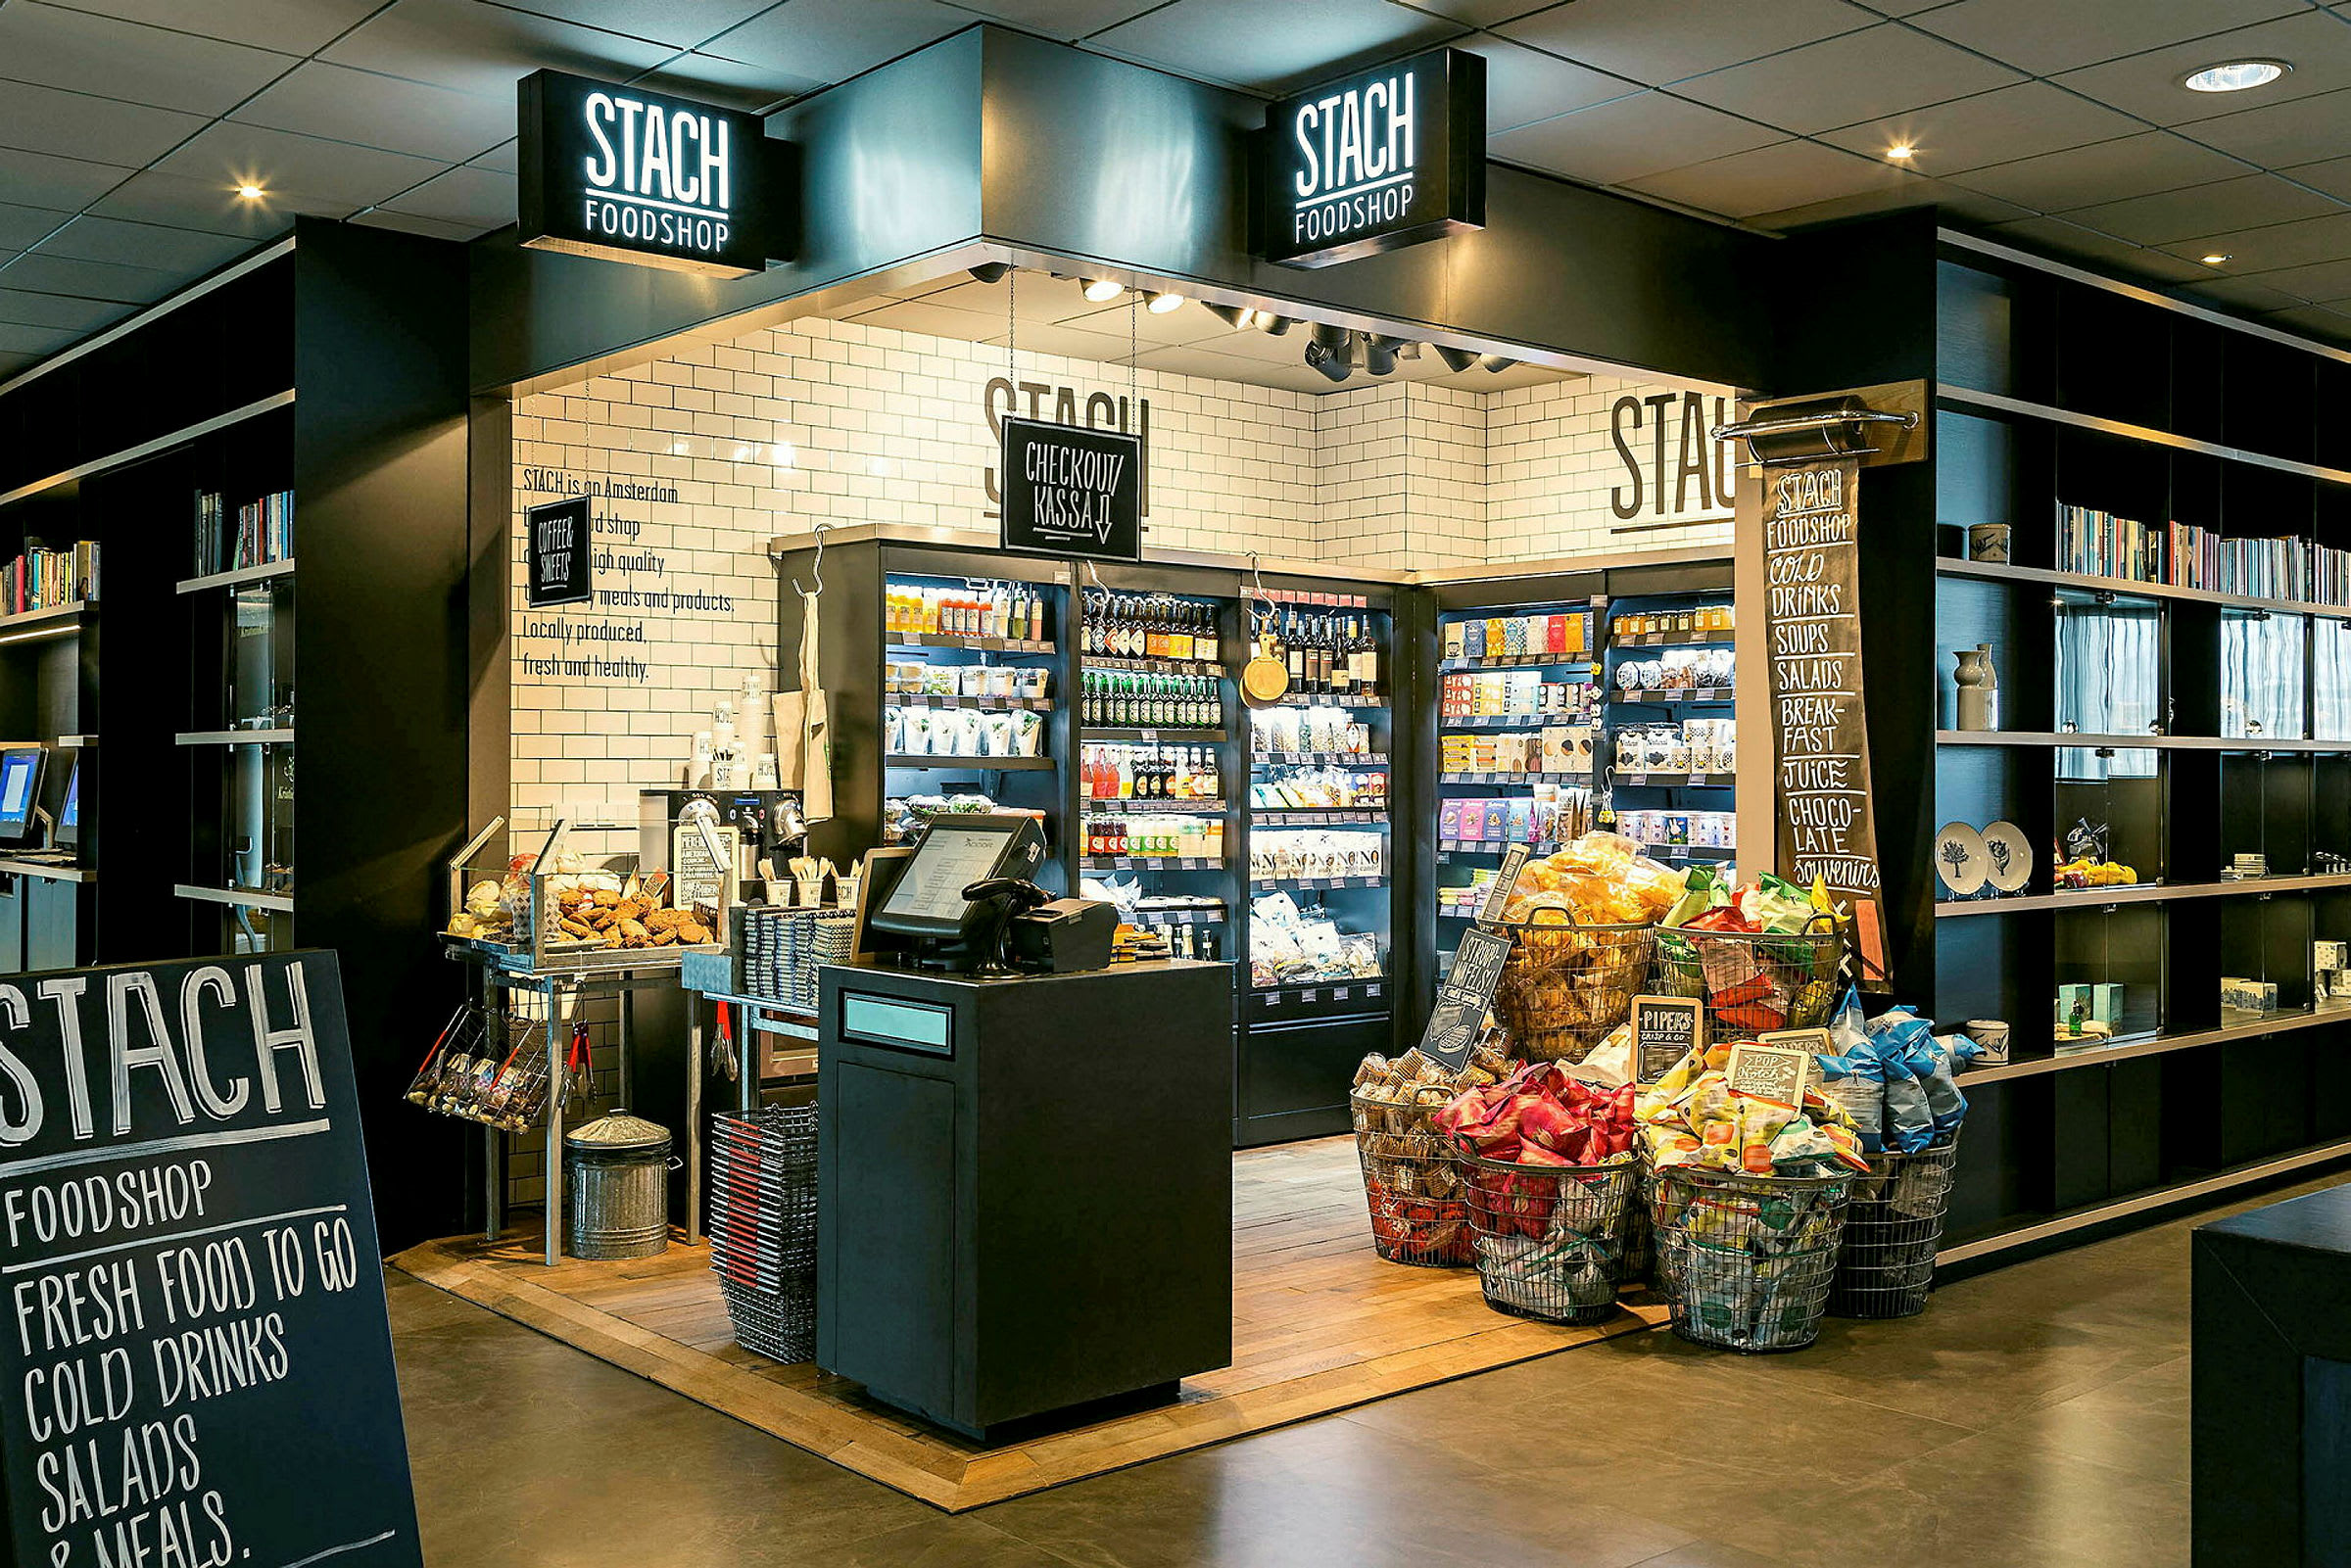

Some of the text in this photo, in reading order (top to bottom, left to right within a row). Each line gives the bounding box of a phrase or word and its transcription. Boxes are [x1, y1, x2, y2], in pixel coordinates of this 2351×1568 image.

[585, 92, 729, 210] STACH
[1295, 71, 1414, 197] STACH
[585, 200, 729, 253] FOODSHOP
[1295, 184, 1414, 244] FOODSHOP
[1610, 391, 1735, 520] STAC
[523, 468, 679, 504] STACH is an Amsterdam
[1776, 469, 1842, 513] STACH
[1033, 485, 1093, 530] KASSA
[606, 512, 641, 542] shop
[1766, 513, 1851, 549] FOODSHOP
[541, 551, 571, 583] SWEETS
[593, 547, 665, 579] igh quality
[1769, 553, 1824, 585] COLD
[600, 585, 641, 607] meals
[644, 588, 669, 609] and
[672, 589, 735, 615] products.
[523, 615, 647, 646] Locally produced,
[1775, 623, 1830, 655] SOUPS
[524, 652, 649, 685] fresh and healthy.
[1777, 660, 1843, 690] SALADS
[1783, 727, 1838, 754] FAST
[1793, 827, 1850, 854] LATE
[1643, 1010, 1692, 1032] PIPERS
[0, 960, 326, 1147] STACH
[1754, 1056, 1779, 1067] POP
[4, 1160, 212, 1247] FOODSHOP
[14, 1216, 358, 1355] FRESH FOOD TO GO
[24, 1312, 289, 1443] COLD DRINKS
[37, 1413, 201, 1534] SALADS
